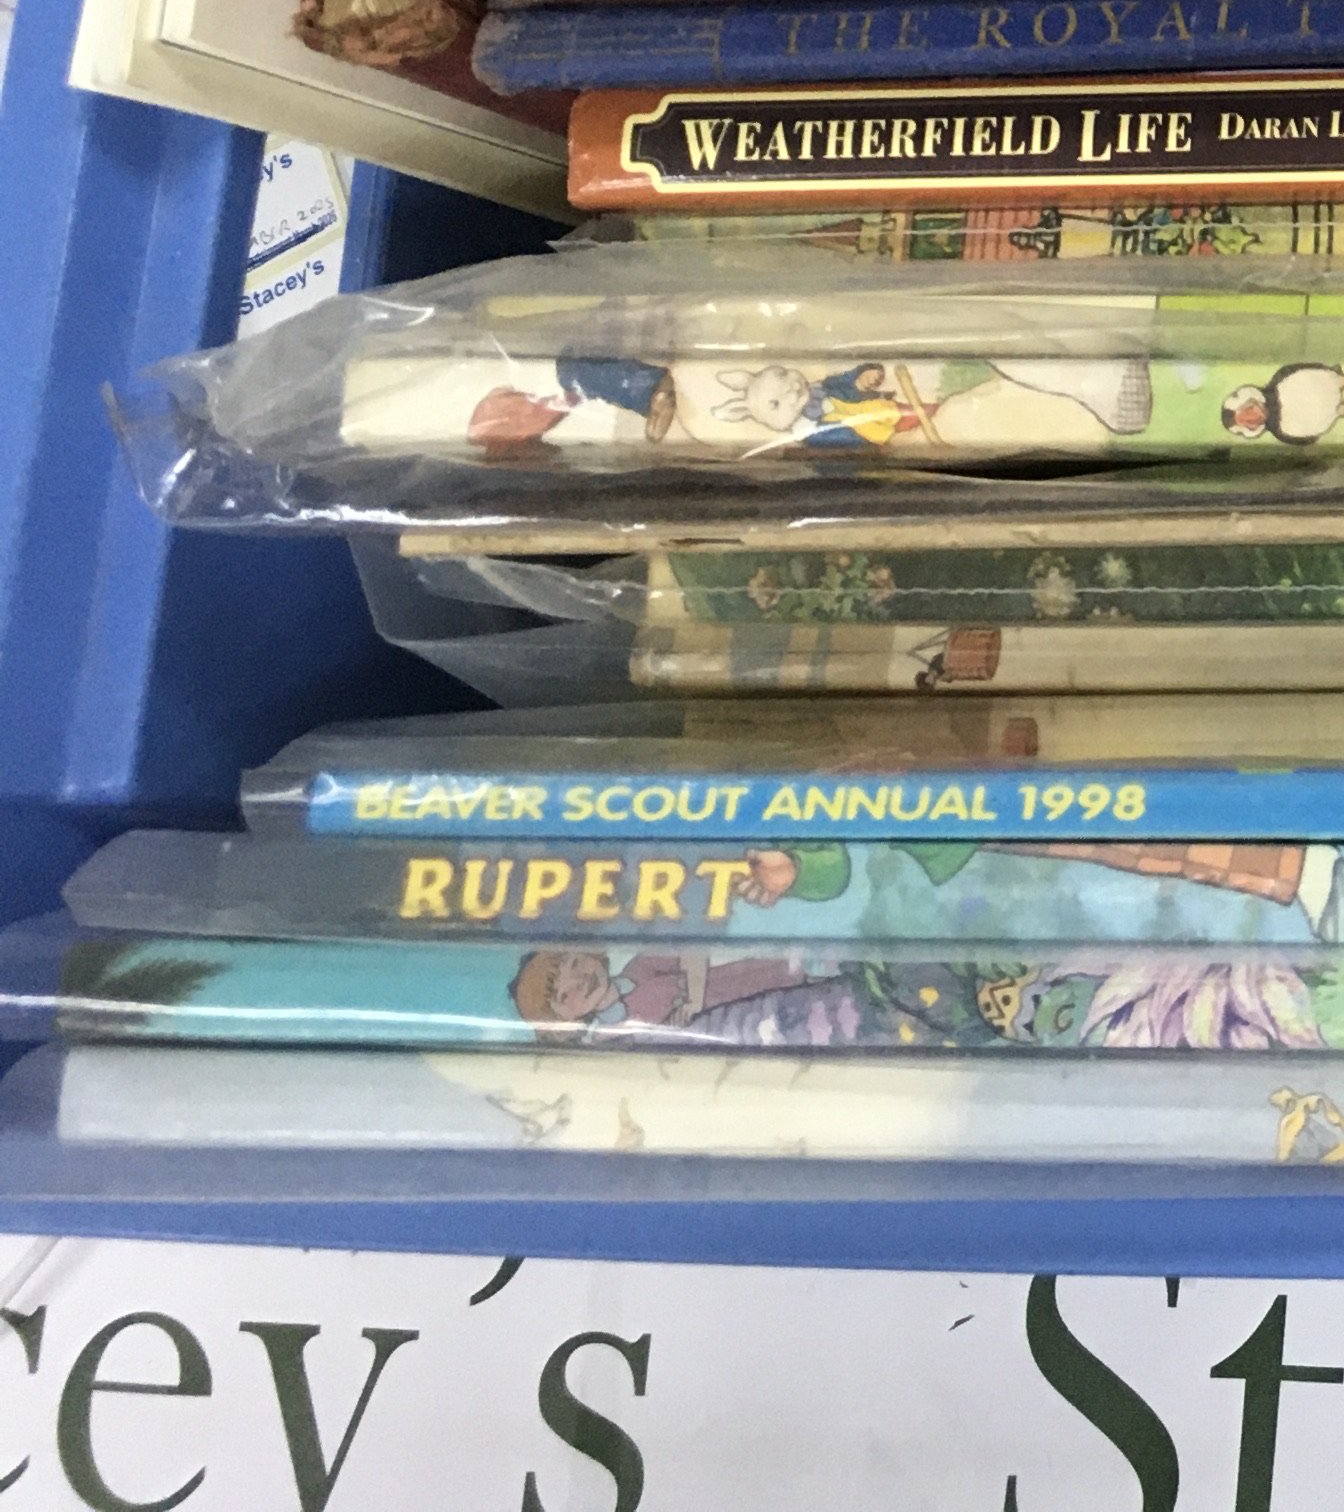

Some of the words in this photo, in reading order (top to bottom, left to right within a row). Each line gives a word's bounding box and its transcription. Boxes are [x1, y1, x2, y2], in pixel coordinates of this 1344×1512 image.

[777, 8, 930, 56] THE
[354, 782, 549, 823] BEAVER
[561, 782, 752, 823] SCOUT
[762, 782, 998, 822] ANNUAL
[1016, 781, 1147, 822] 1998
[399, 856, 753, 921] RUPERT
